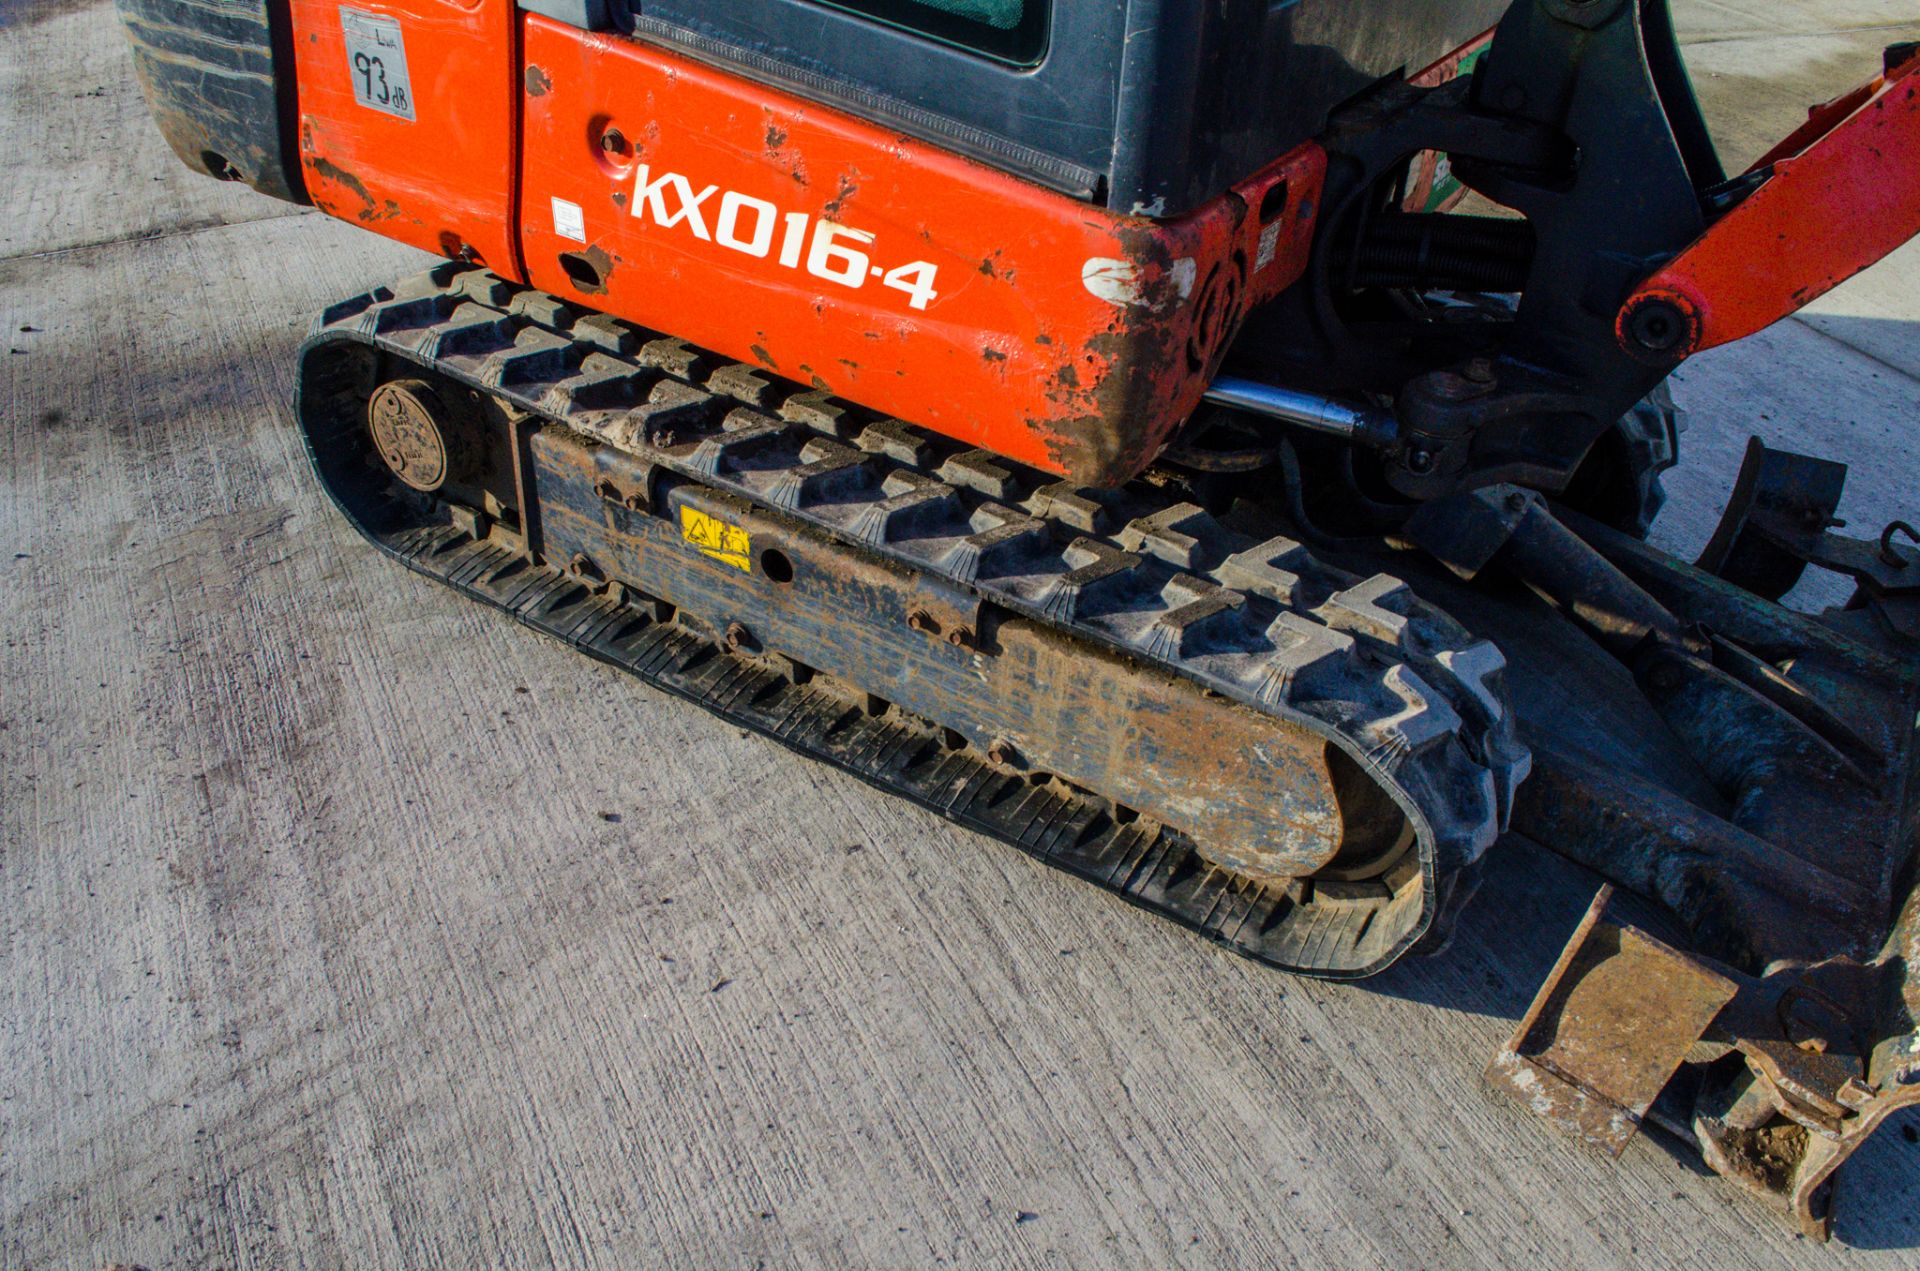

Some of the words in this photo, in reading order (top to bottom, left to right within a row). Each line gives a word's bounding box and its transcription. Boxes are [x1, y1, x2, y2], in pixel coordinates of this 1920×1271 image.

[354, 51, 390, 104] 93
[392, 86, 408, 110] dB
[630, 163, 938, 311] KX016-4
